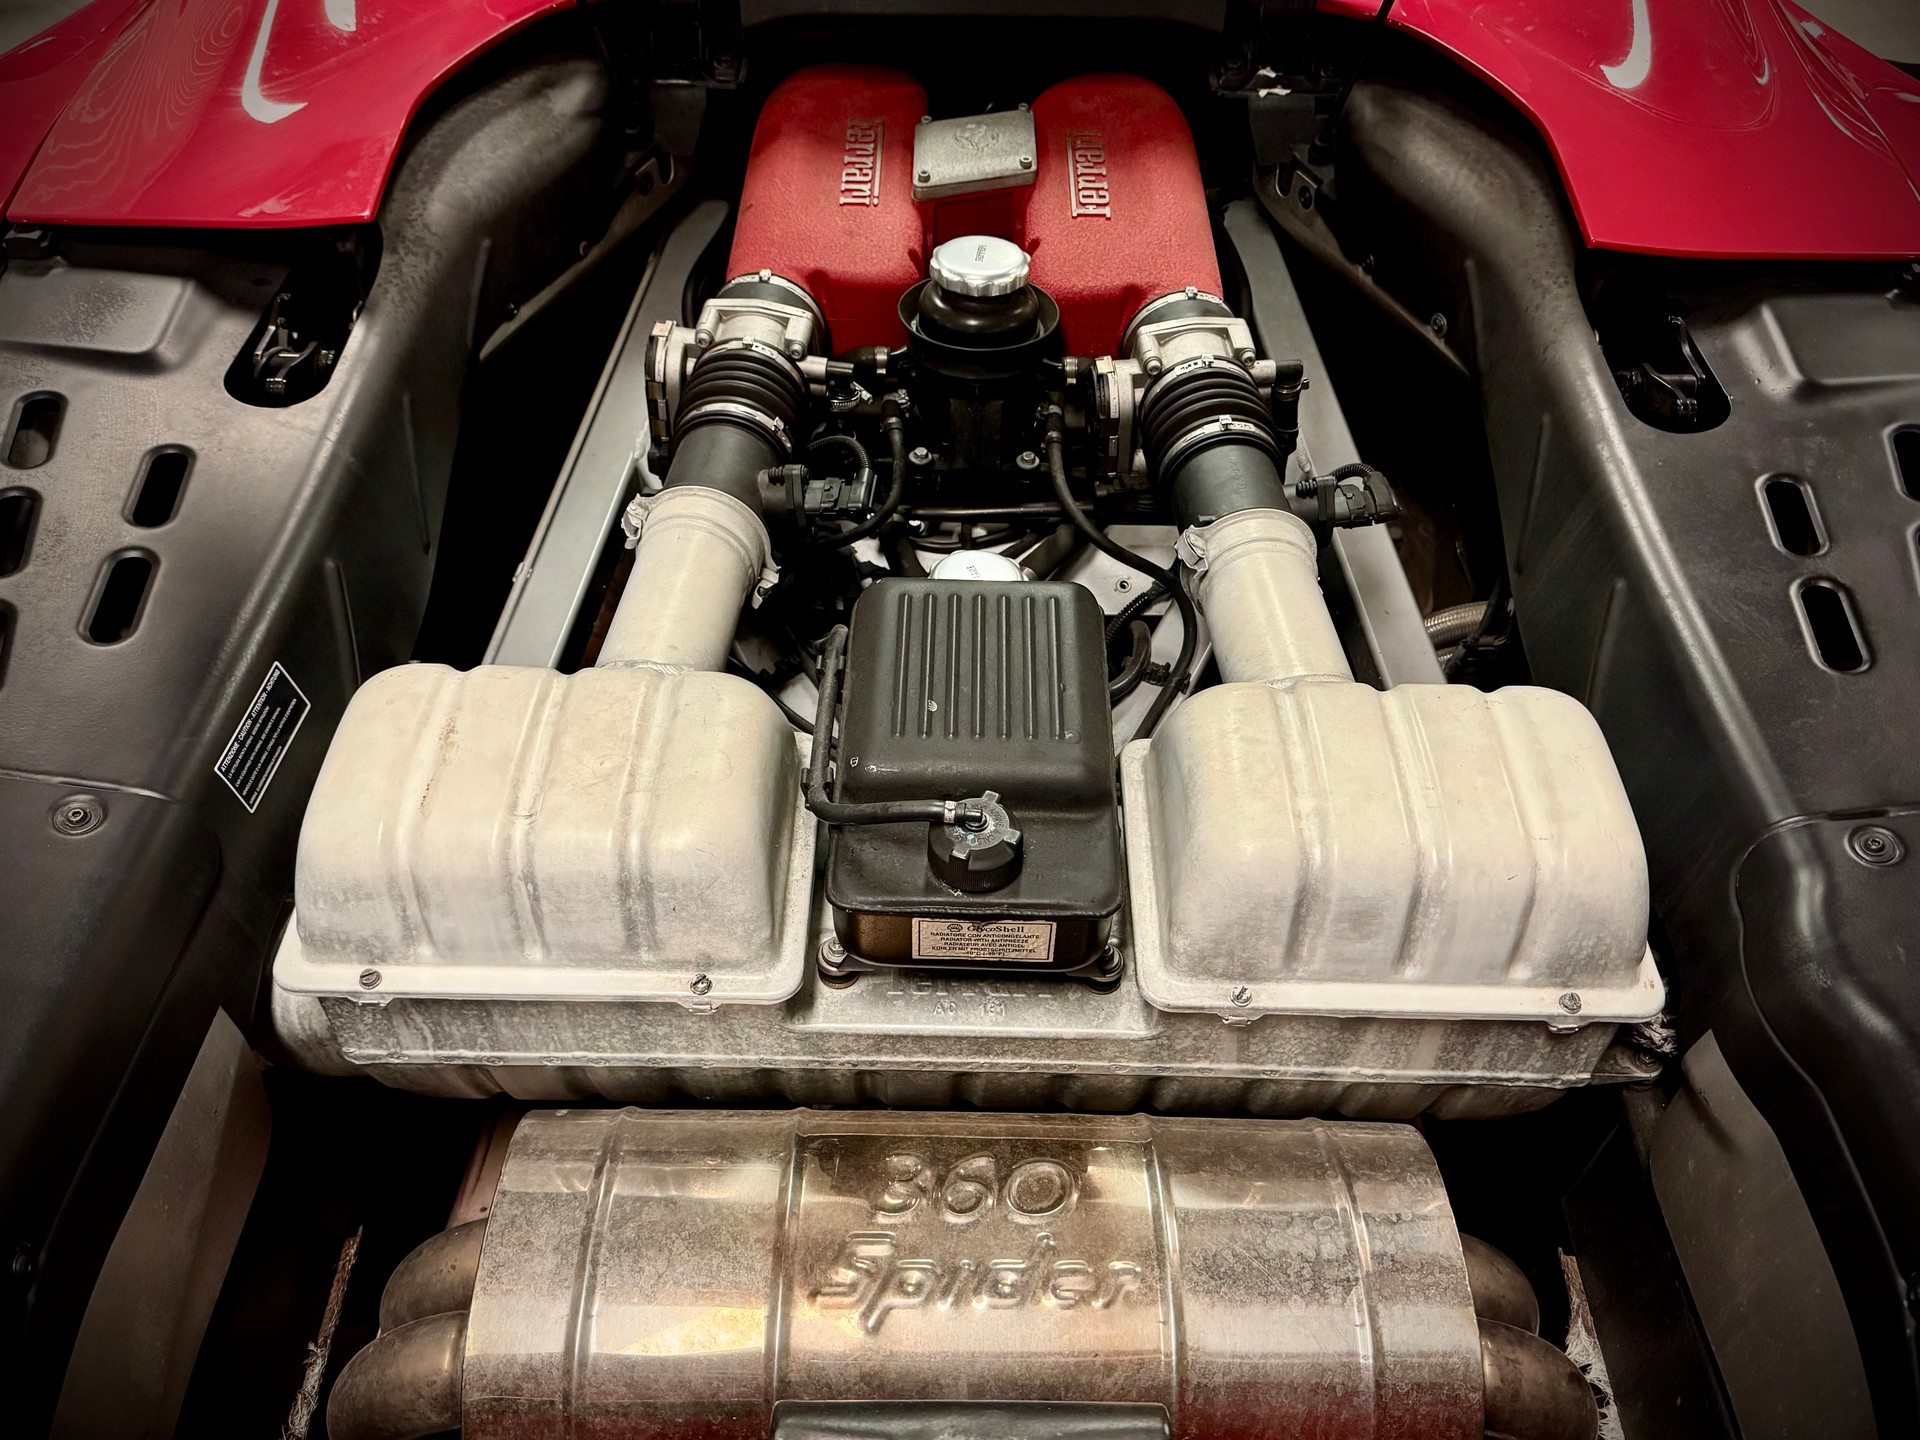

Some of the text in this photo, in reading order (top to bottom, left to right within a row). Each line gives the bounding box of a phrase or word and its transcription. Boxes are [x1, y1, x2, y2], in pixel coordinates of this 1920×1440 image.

[839, 118, 885, 206] Ferrari
[1065, 129, 1112, 219] Ferrari
[221, 669, 280, 772] ATTENZIONE CAUTION ATTENTION ACHTUNG
[871, 1153, 1082, 1221] 360
[806, 1230, 1142, 1334] Spider
